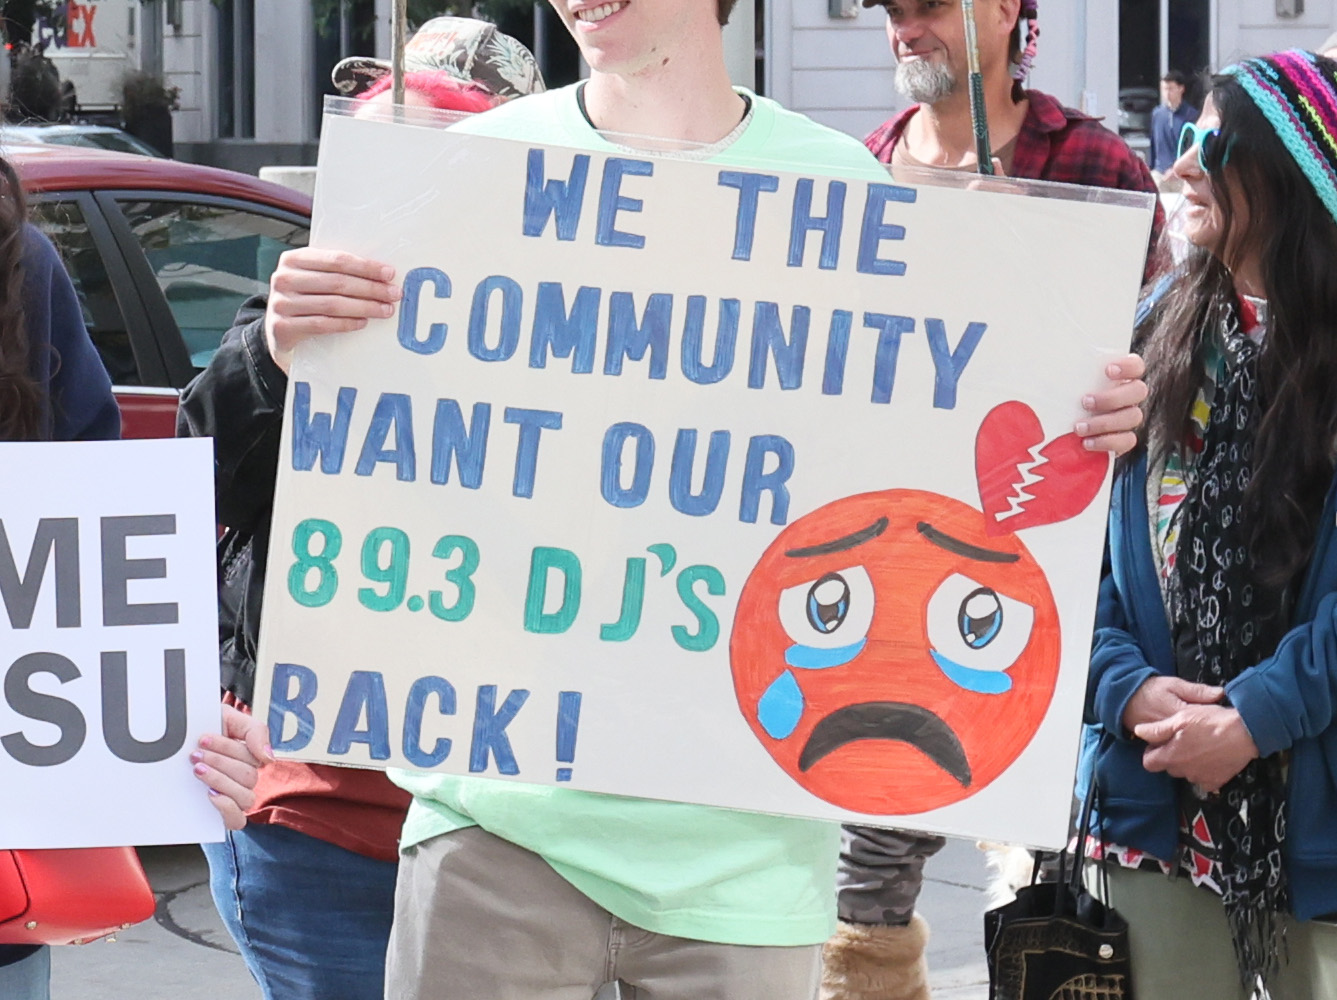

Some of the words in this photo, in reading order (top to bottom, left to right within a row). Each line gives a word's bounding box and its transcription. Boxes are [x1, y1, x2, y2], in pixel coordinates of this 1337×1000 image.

[522, 148, 654, 249] WE
[717, 170, 918, 276] THE
[396, 265, 987, 409] COMMUNITY
[291, 381, 563, 499] WANT
[600, 421, 795, 526] OUR
[287, 518, 480, 622] 89.3
